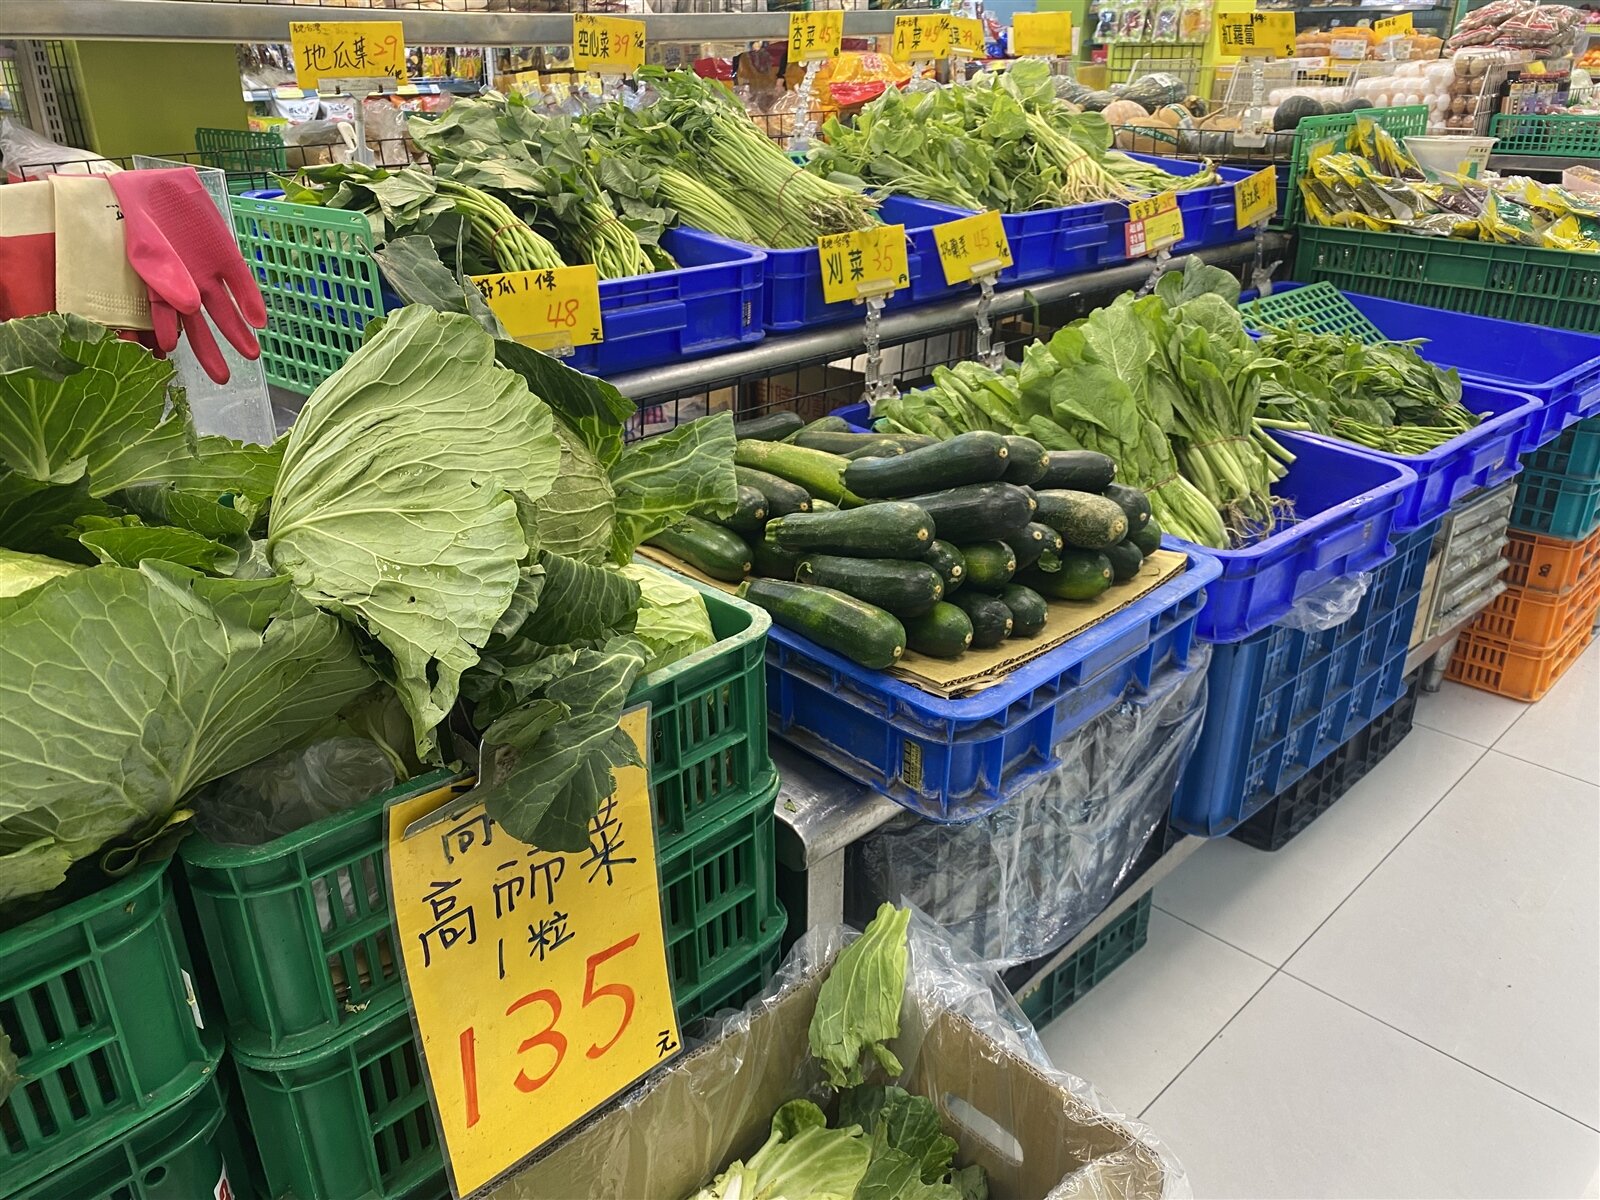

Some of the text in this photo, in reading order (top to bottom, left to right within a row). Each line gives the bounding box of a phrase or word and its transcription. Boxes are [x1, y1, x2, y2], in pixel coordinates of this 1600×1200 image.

[373, 35, 398, 61] 29
[578, 28, 610, 59] 空心菜
[614, 34, 630, 57] 39
[793, 25, 833, 50] 杏菜 45
[973, 226, 990, 249] 45
[1171, 222, 1182, 236] 22
[826, 244, 894, 286] 刈菜 35
[546, 298, 580, 328] 48
[590, 327, 604, 341] 元
[459, 932, 641, 1129] 135
[655, 1029, 677, 1058] 元
